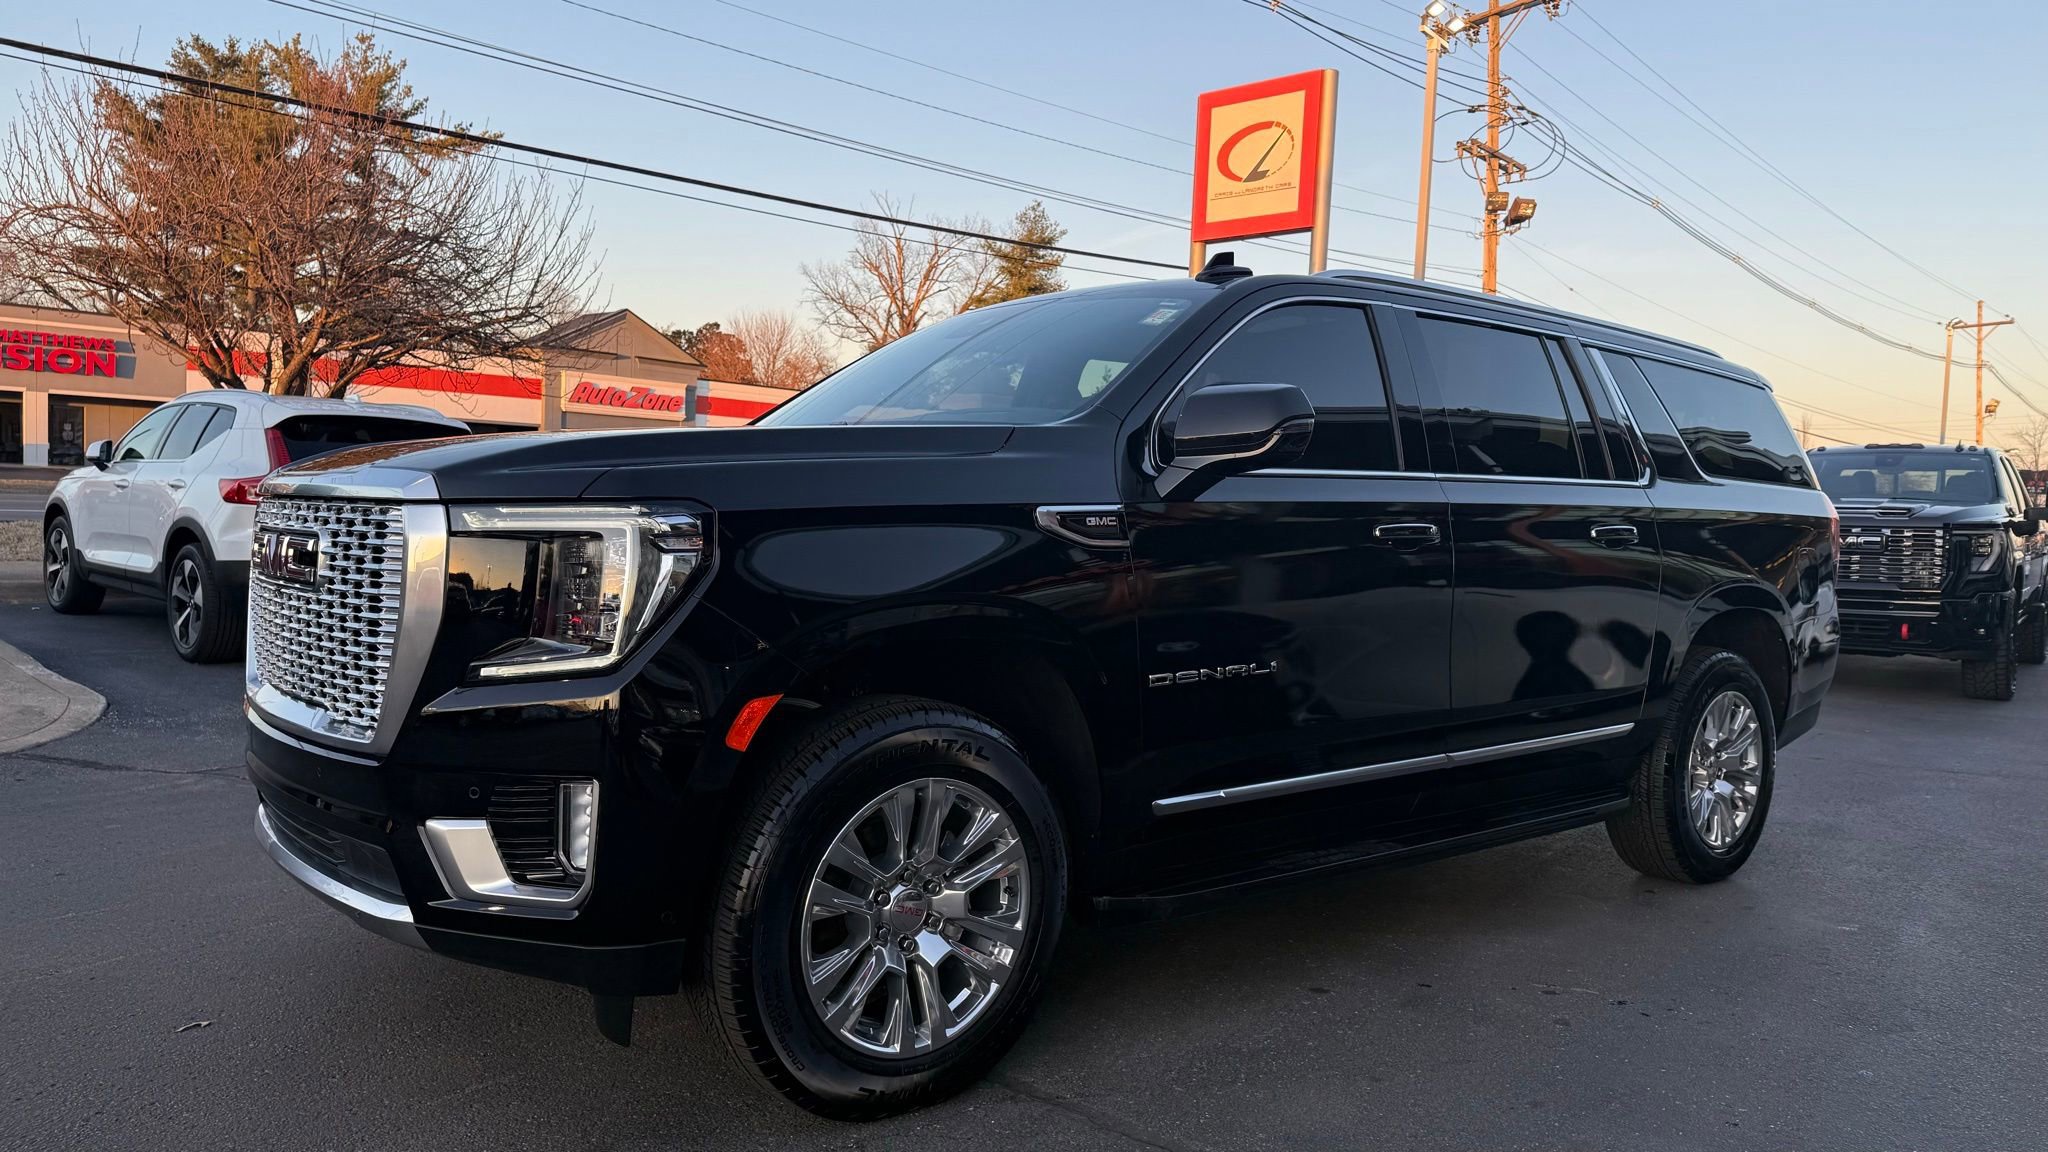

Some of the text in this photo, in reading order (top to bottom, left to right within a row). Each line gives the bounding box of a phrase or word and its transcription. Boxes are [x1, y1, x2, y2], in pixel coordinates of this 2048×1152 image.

[0, 343, 116, 378] SION
[569, 381, 684, 413] AutoZone
[1086, 516, 1117, 526] GMC
[1839, 536, 1881, 549] MC
[1149, 660, 1278, 688] DENALI
[895, 905, 924, 917] GMC
